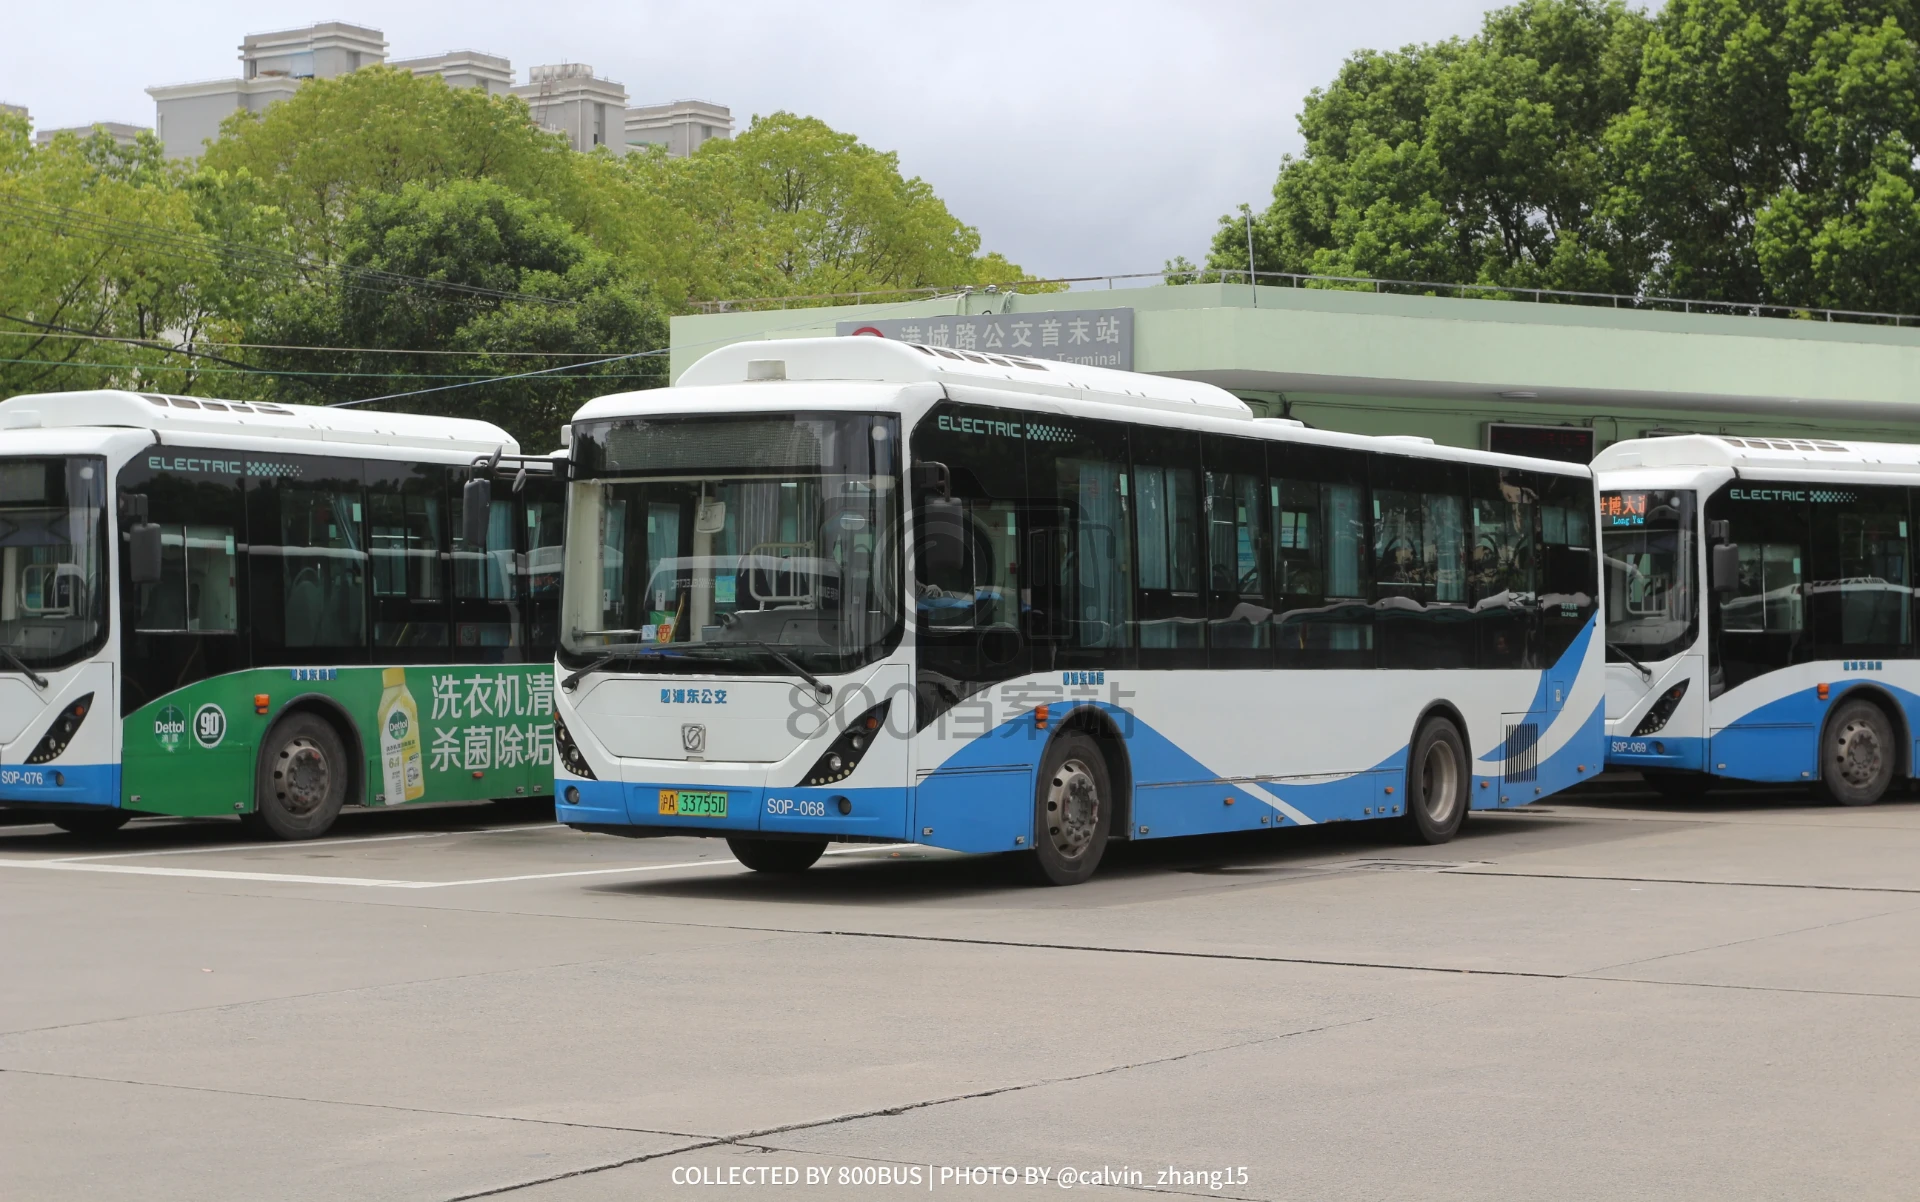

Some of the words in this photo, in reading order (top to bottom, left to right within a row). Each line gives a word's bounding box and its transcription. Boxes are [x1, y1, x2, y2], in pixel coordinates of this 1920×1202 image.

[900, 315, 1121, 351] 港城路公交首末站
[938, 415, 1022, 438] ELECTRIC
[148, 456, 242, 474] ELECTRIC
[1730, 489, 1806, 501] ELECTRIC
[1612, 515, 1630, 526] Long
[430, 671, 554, 720] 洗衣机清
[672, 688, 728, 704] 浦东公交
[155, 720, 185, 734] Dettol
[430, 722, 554, 773] 杀菌除垢
